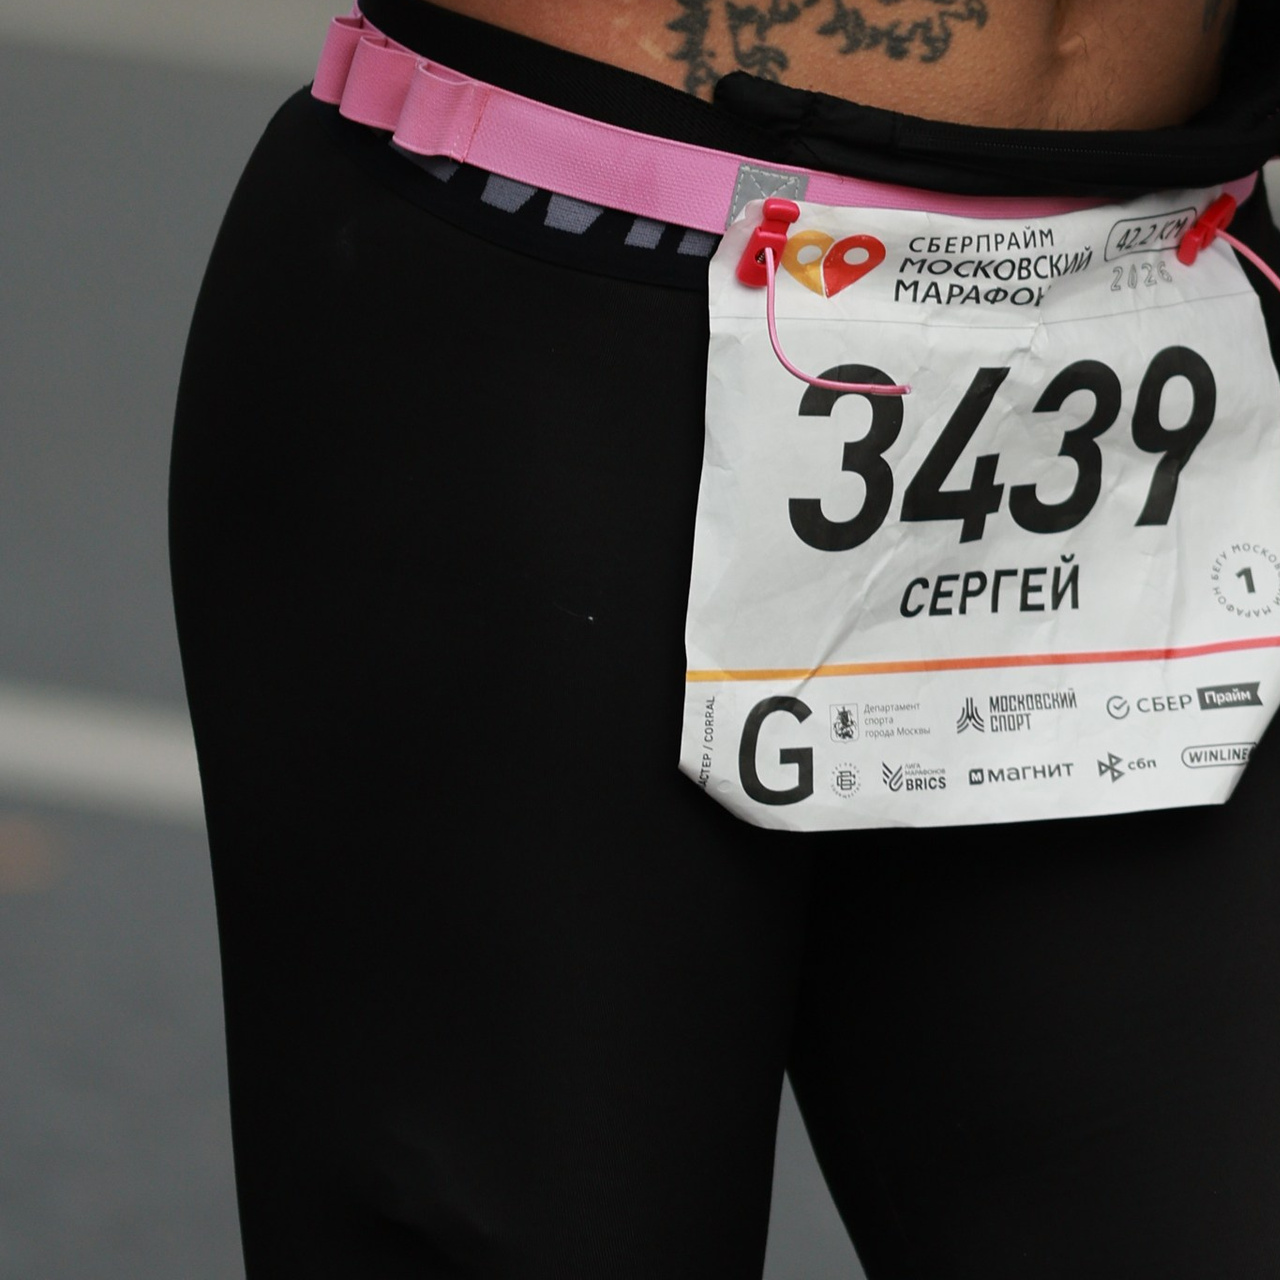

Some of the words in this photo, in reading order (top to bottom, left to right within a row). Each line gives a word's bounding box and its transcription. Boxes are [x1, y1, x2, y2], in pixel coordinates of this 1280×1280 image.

[908, 225, 1055, 255] СБЕРПРАЙМ
[898, 245, 1094, 282] МОСКОВСКИЙ
[787, 344, 1217, 553] 3439
[1211, 551, 1228, 581] БЕГУ
[1235, 565, 1257, 595] 1
[898, 553, 1081, 619] СЕРГЕЙ
[1212, 586, 1272, 619] МАРАФОН
[863, 702, 921, 715] Департамент
[989, 687, 1078, 714] МОСКОВСКИЙ
[1136, 694, 1193, 713] СБЕР
[1204, 688, 1251, 706] Прайм
[704, 696, 716, 743] CORRAL
[864, 716, 894, 727] спорта
[865, 728, 895, 740] города
[896, 726, 931, 737] Москвы
[990, 712, 1032, 733] СПОРТ
[738, 695, 815, 807] G
[1127, 758, 1157, 771] сбп
[905, 776, 947, 792] BRICS
